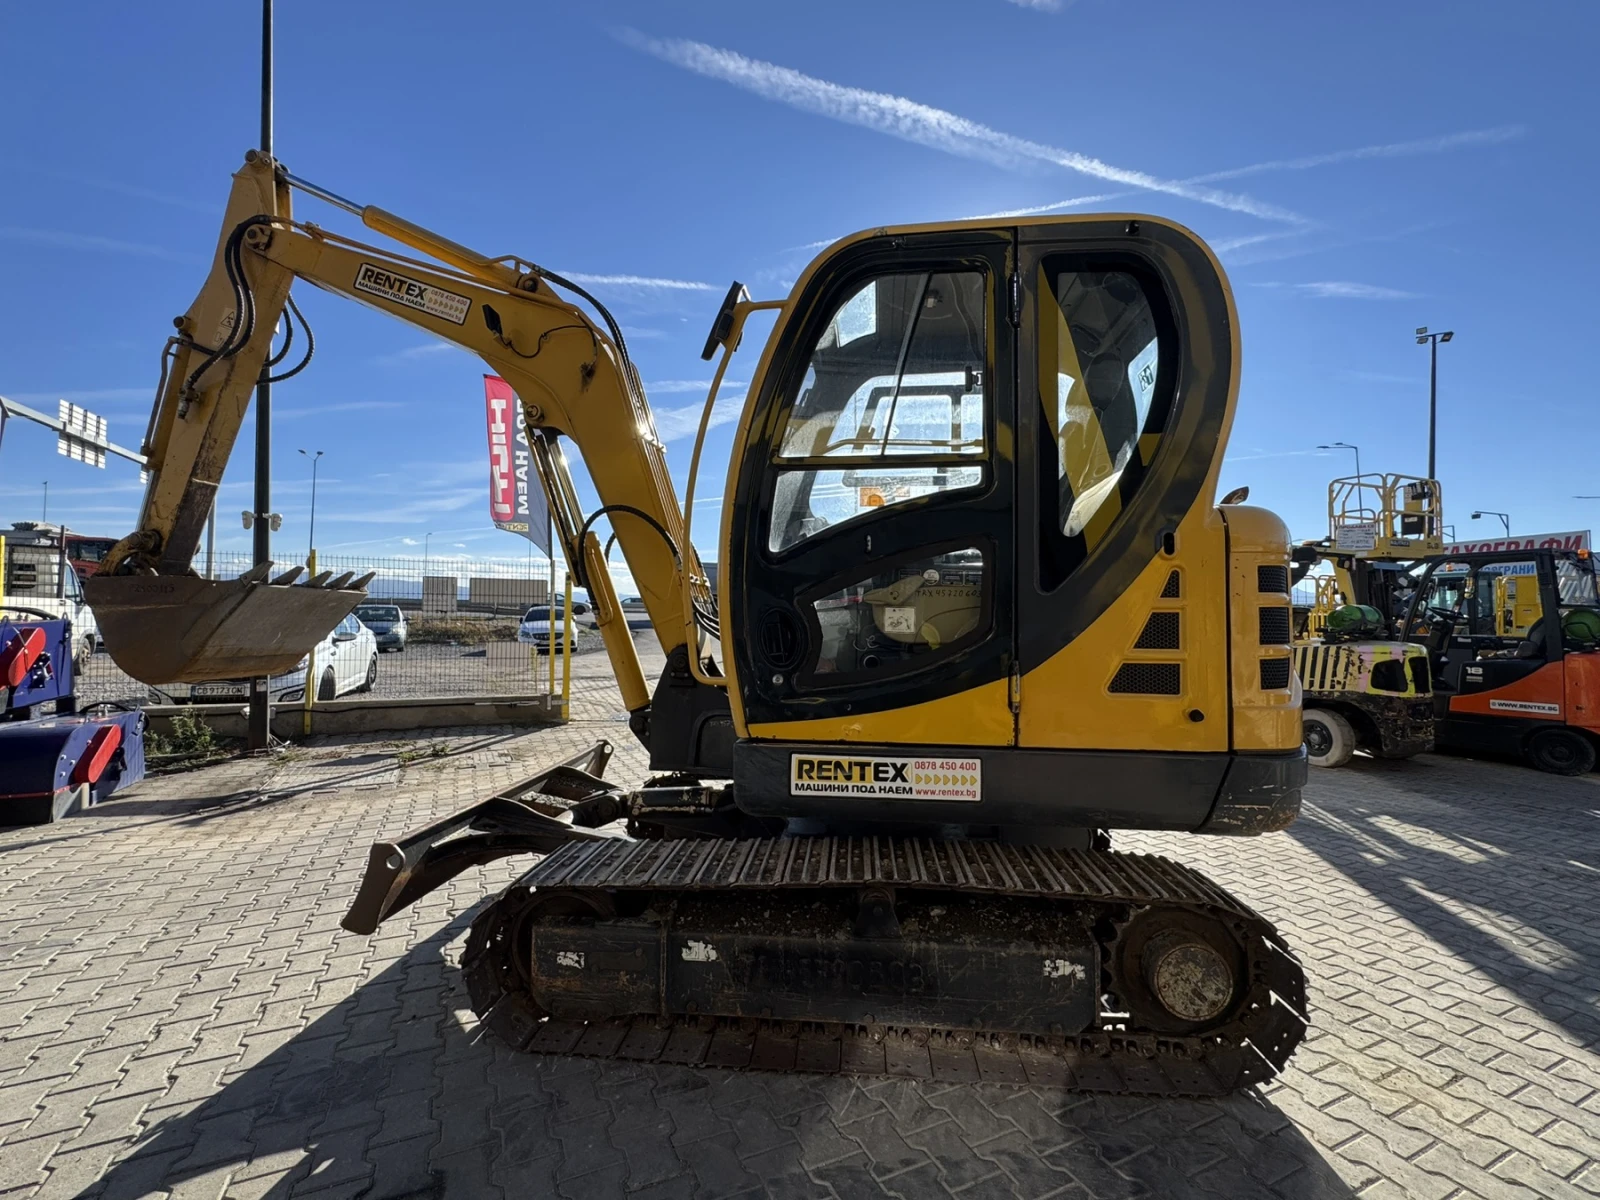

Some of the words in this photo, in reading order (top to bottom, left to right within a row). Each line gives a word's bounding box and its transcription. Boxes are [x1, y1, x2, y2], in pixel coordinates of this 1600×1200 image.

[362, 267, 429, 301] RENTEX
[358, 281, 390, 297] МАШИНИ
[390, 291, 404, 302] ПОД
[405, 296, 426, 309] НАЕМ
[430, 289, 444, 299] 0878
[445, 293, 456, 303] 450
[456, 298, 468, 307] 400
[426, 305, 462, 322] www.rentex.bg
[1466, 666, 1483, 675] 18
[1497, 702, 1558, 712] WWW.RENTEX.BG
[797, 759, 909, 783] RENTEX
[914, 761, 937, 770] 0878
[939, 761, 957, 771] 450
[959, 762, 977, 771] 400
[794, 783, 849, 793] МАШИНИ
[851, 785, 877, 794] ПОД
[879, 785, 913, 795] НАЕМ
[915, 788, 977, 799] www.rentex.bg
